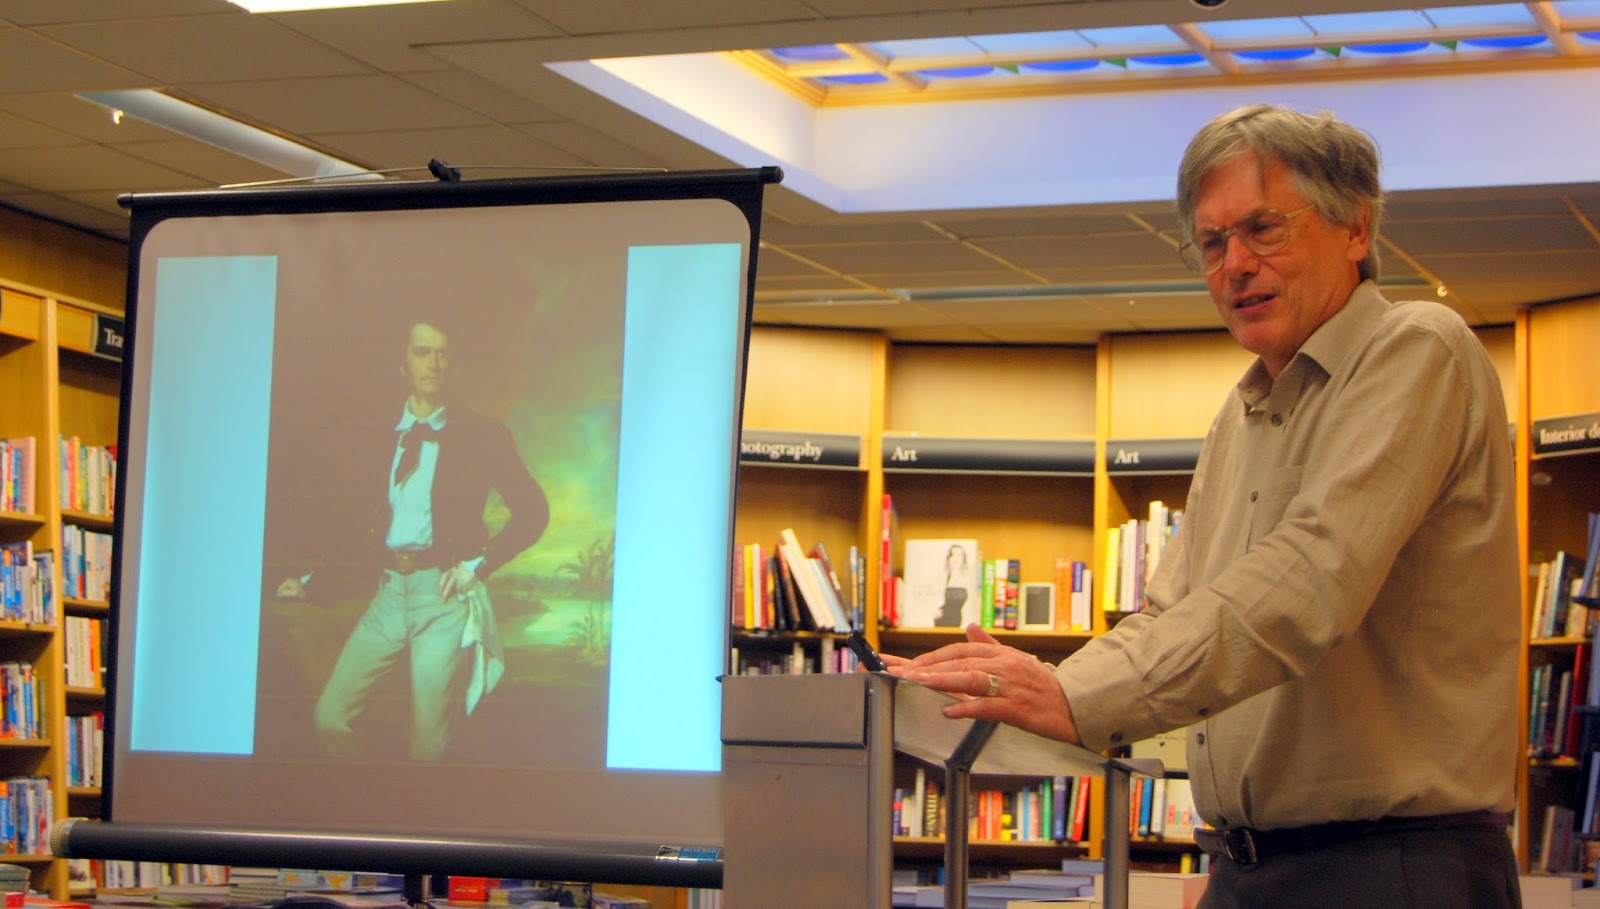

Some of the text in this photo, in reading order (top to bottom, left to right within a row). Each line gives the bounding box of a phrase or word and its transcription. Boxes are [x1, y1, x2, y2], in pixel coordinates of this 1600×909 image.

[104, 327, 124, 348] Tra
[1541, 425, 1586, 445] Interior
[891, 446, 917, 462] Art
[1114, 449, 1140, 464] Art
